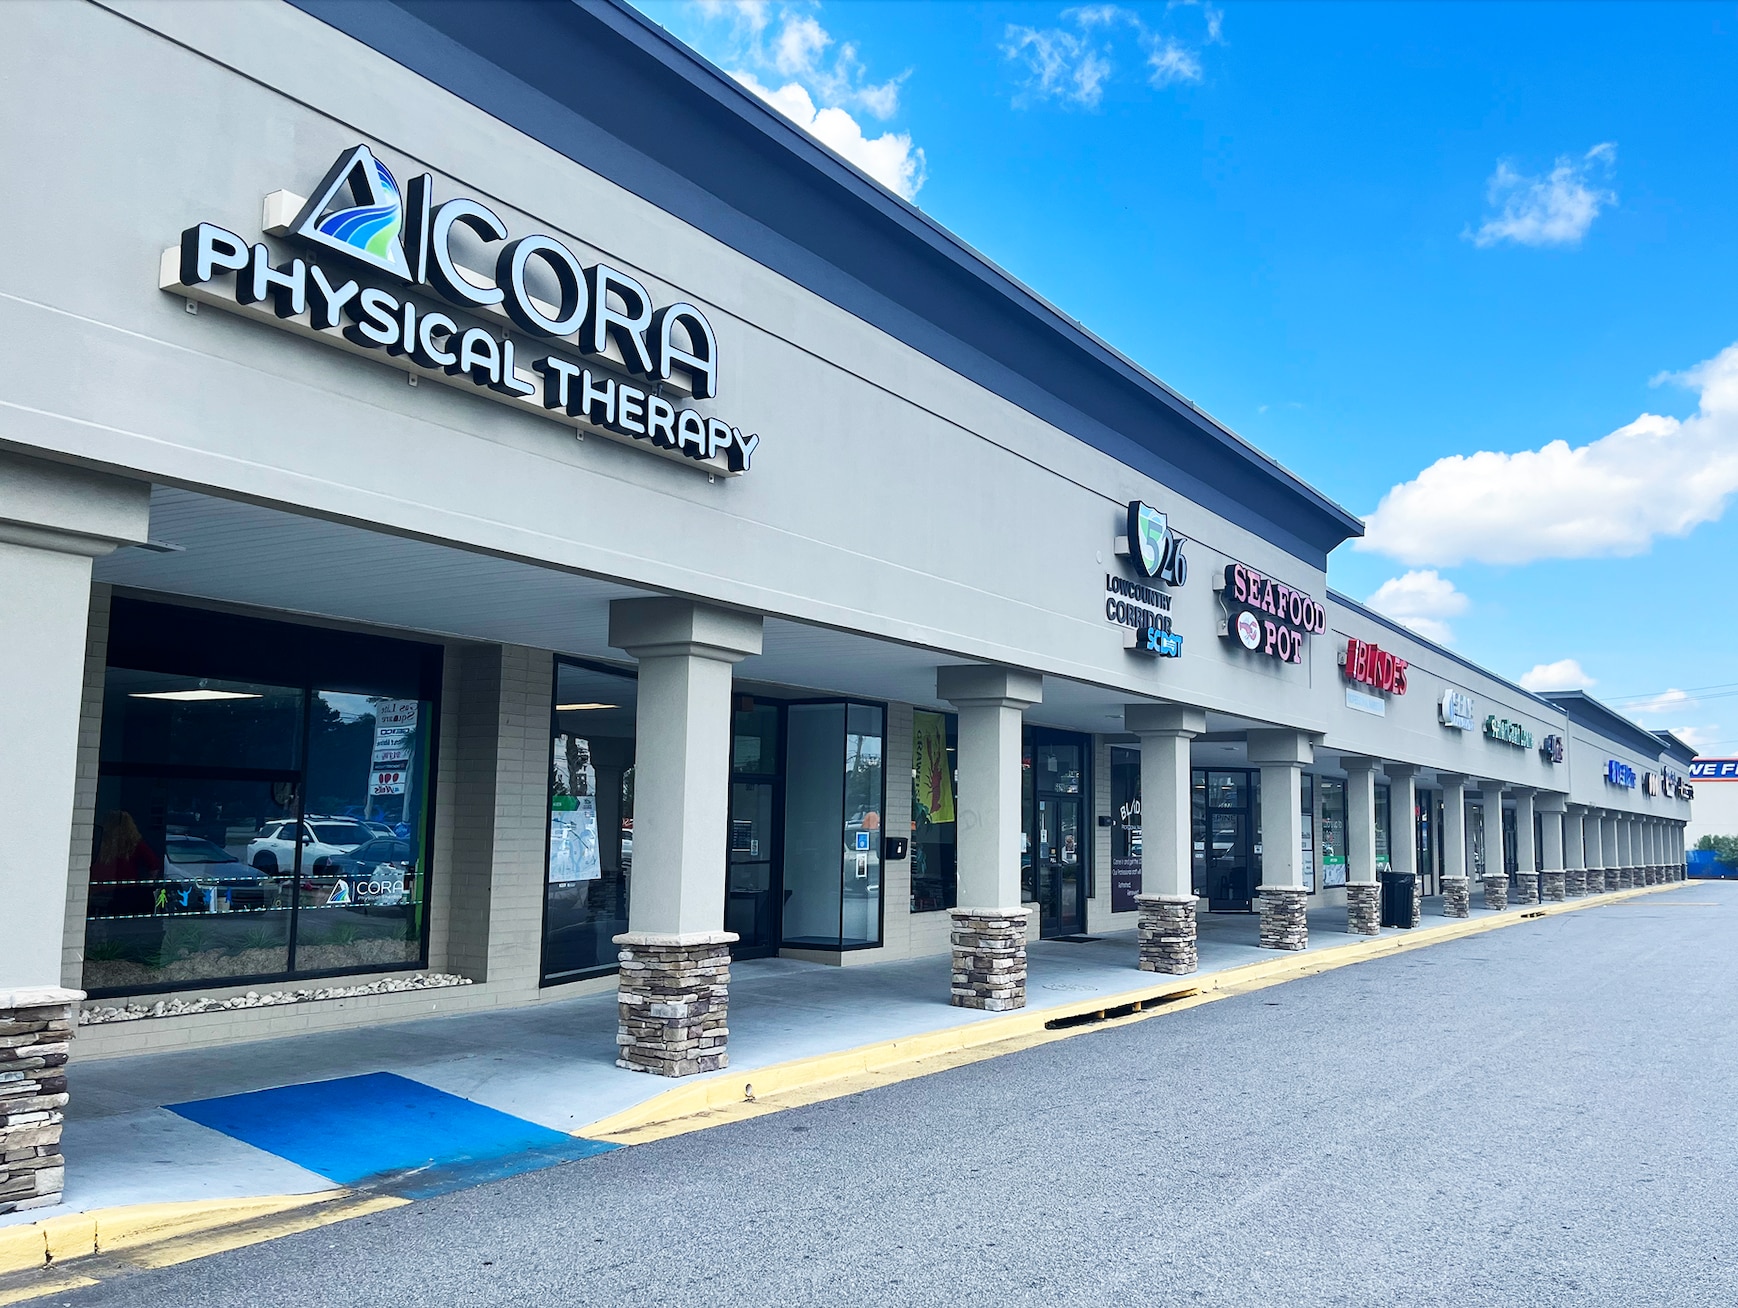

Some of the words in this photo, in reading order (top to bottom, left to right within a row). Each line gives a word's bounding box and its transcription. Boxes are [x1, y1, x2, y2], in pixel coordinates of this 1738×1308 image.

[430, 197, 718, 400] CORA
[194, 222, 536, 397] PHYSICAL
[544, 356, 760, 473] THERAPY
[1146, 518, 1188, 588] 526
[1105, 573, 1172, 612] LOWCOUNTRY
[1105, 597, 1173, 634] CORRIDOR
[1232, 562, 1327, 636] SEAFOOD
[1264, 620, 1303, 665] POT
[356, 880, 404, 895] CORA
